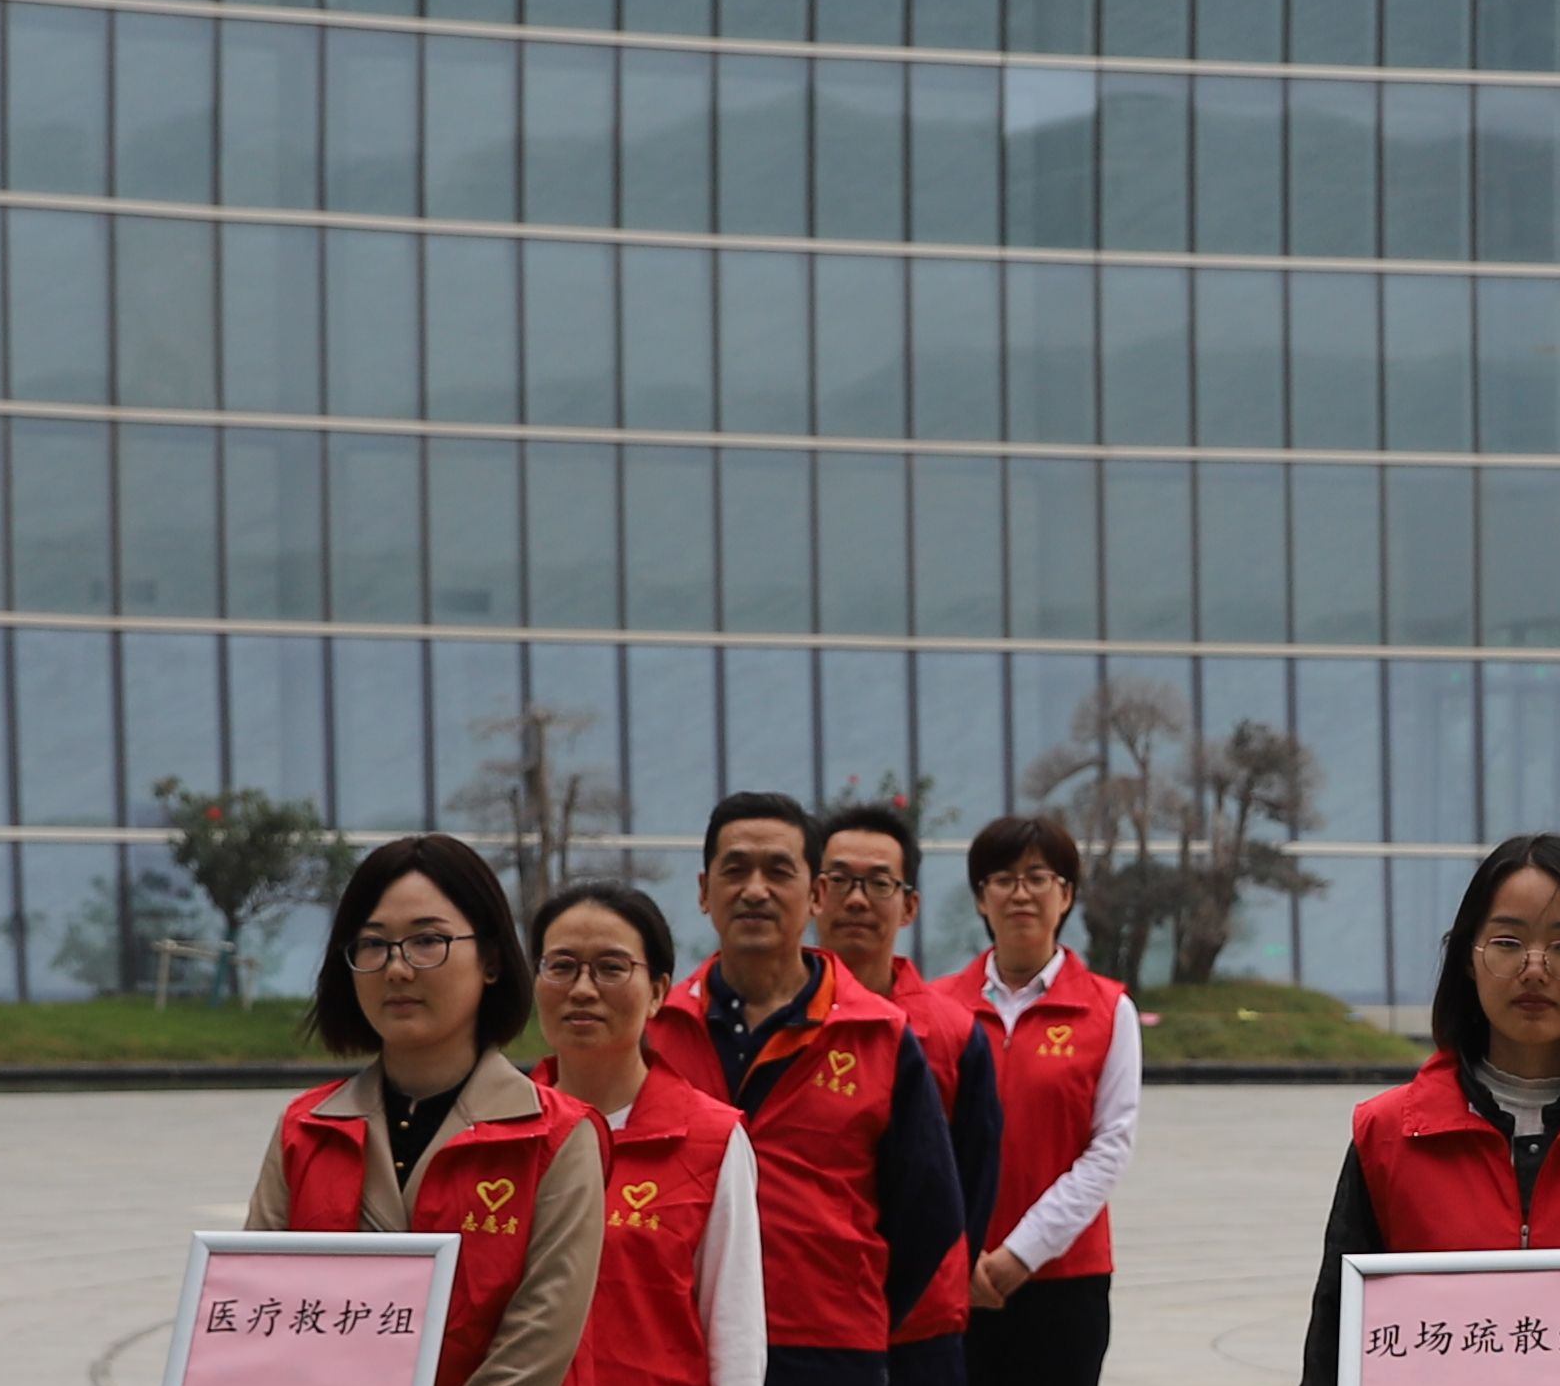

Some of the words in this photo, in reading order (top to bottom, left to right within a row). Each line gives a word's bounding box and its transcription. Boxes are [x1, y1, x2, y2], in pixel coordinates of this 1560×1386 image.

[206, 1297, 415, 1338] 医疗救护组
